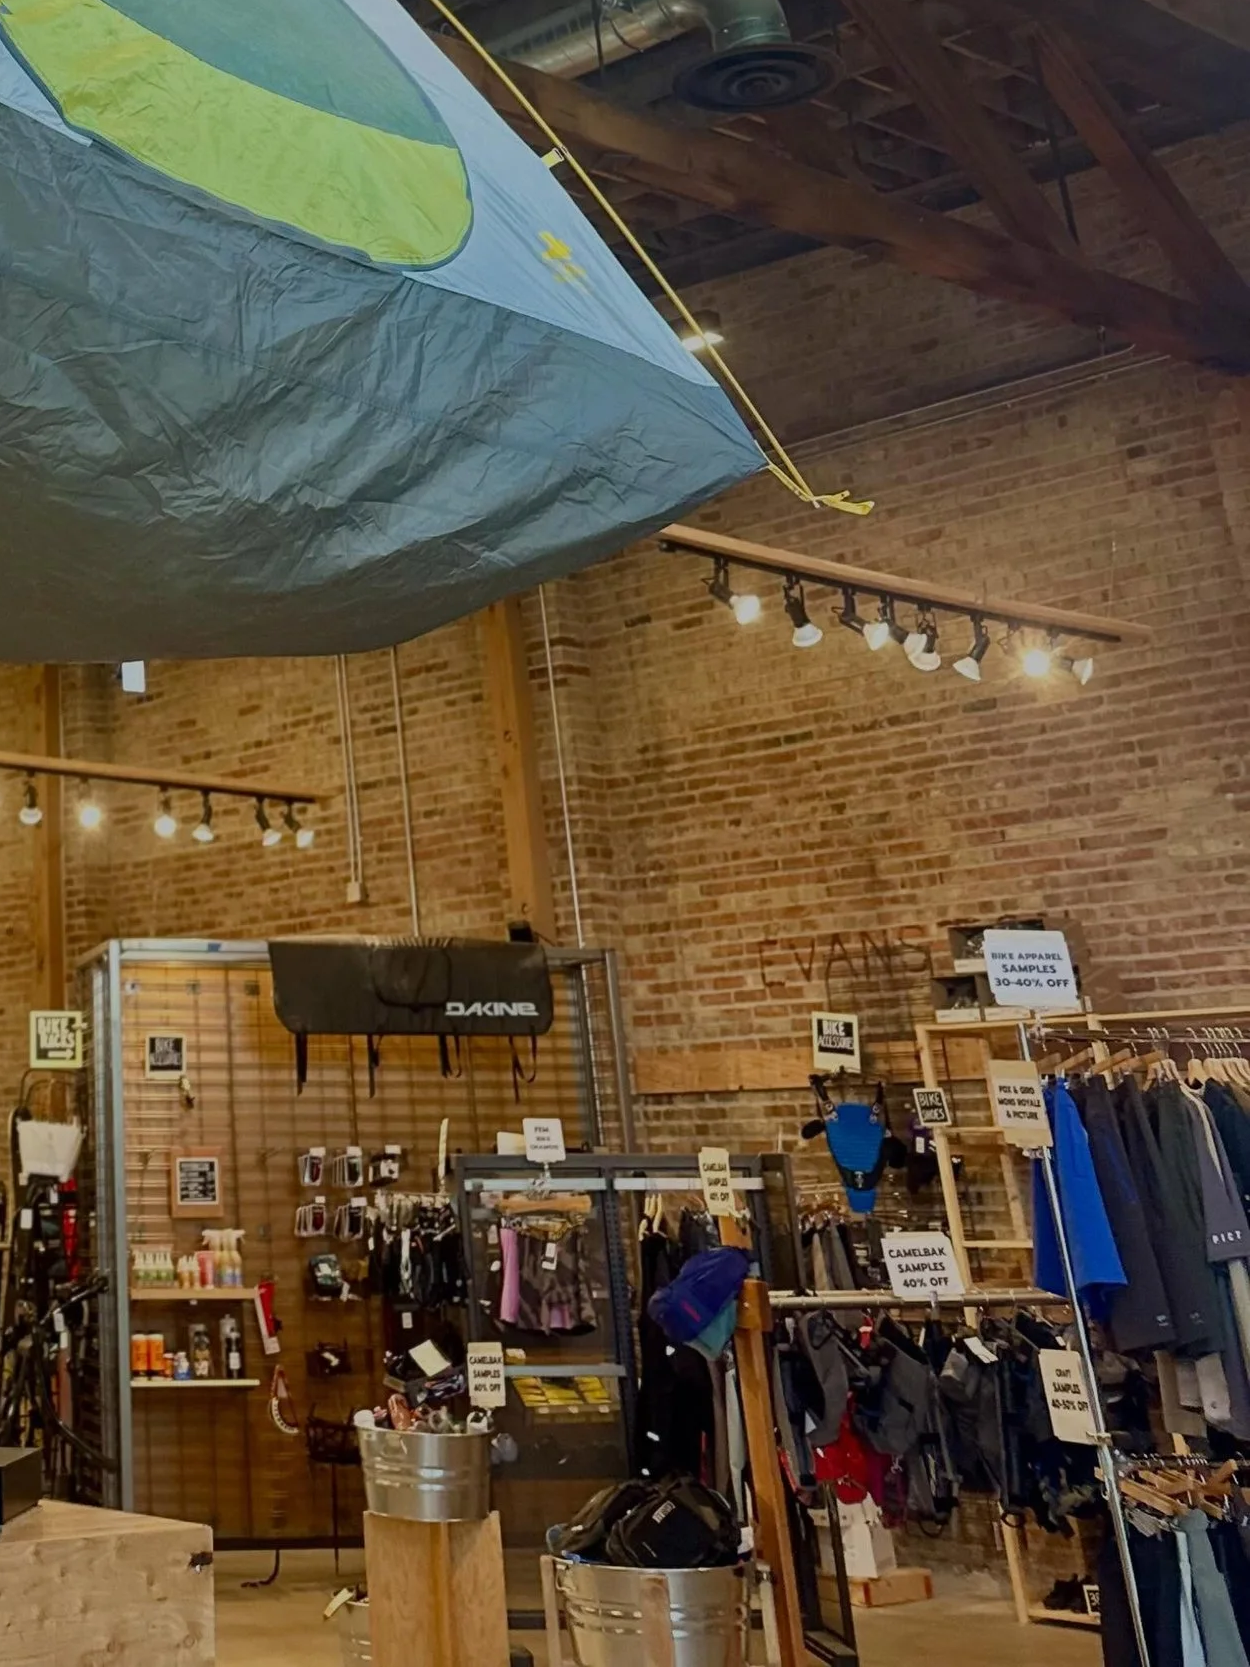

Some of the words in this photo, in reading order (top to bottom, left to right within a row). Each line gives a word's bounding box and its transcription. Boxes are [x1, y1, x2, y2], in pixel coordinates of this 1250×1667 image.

[991, 952, 1014, 960] BIKE
[1018, 952, 1063, 960] APPAREL
[1001, 964, 1057, 973] SAMPLES
[994, 978, 1043, 987] 30-40%
[1047, 978, 1069, 987] OFF
[445, 1001, 539, 1017] DAKINE
[822, 1020, 846, 1036] BIKE
[919, 1093, 942, 1106] BIKE
[889, 1248, 947, 1258] CAMELBAK
[898, 1262, 945, 1273] SAMPLES
[903, 1278, 927, 1288] 40%
[930, 1277, 948, 1286] OFF
